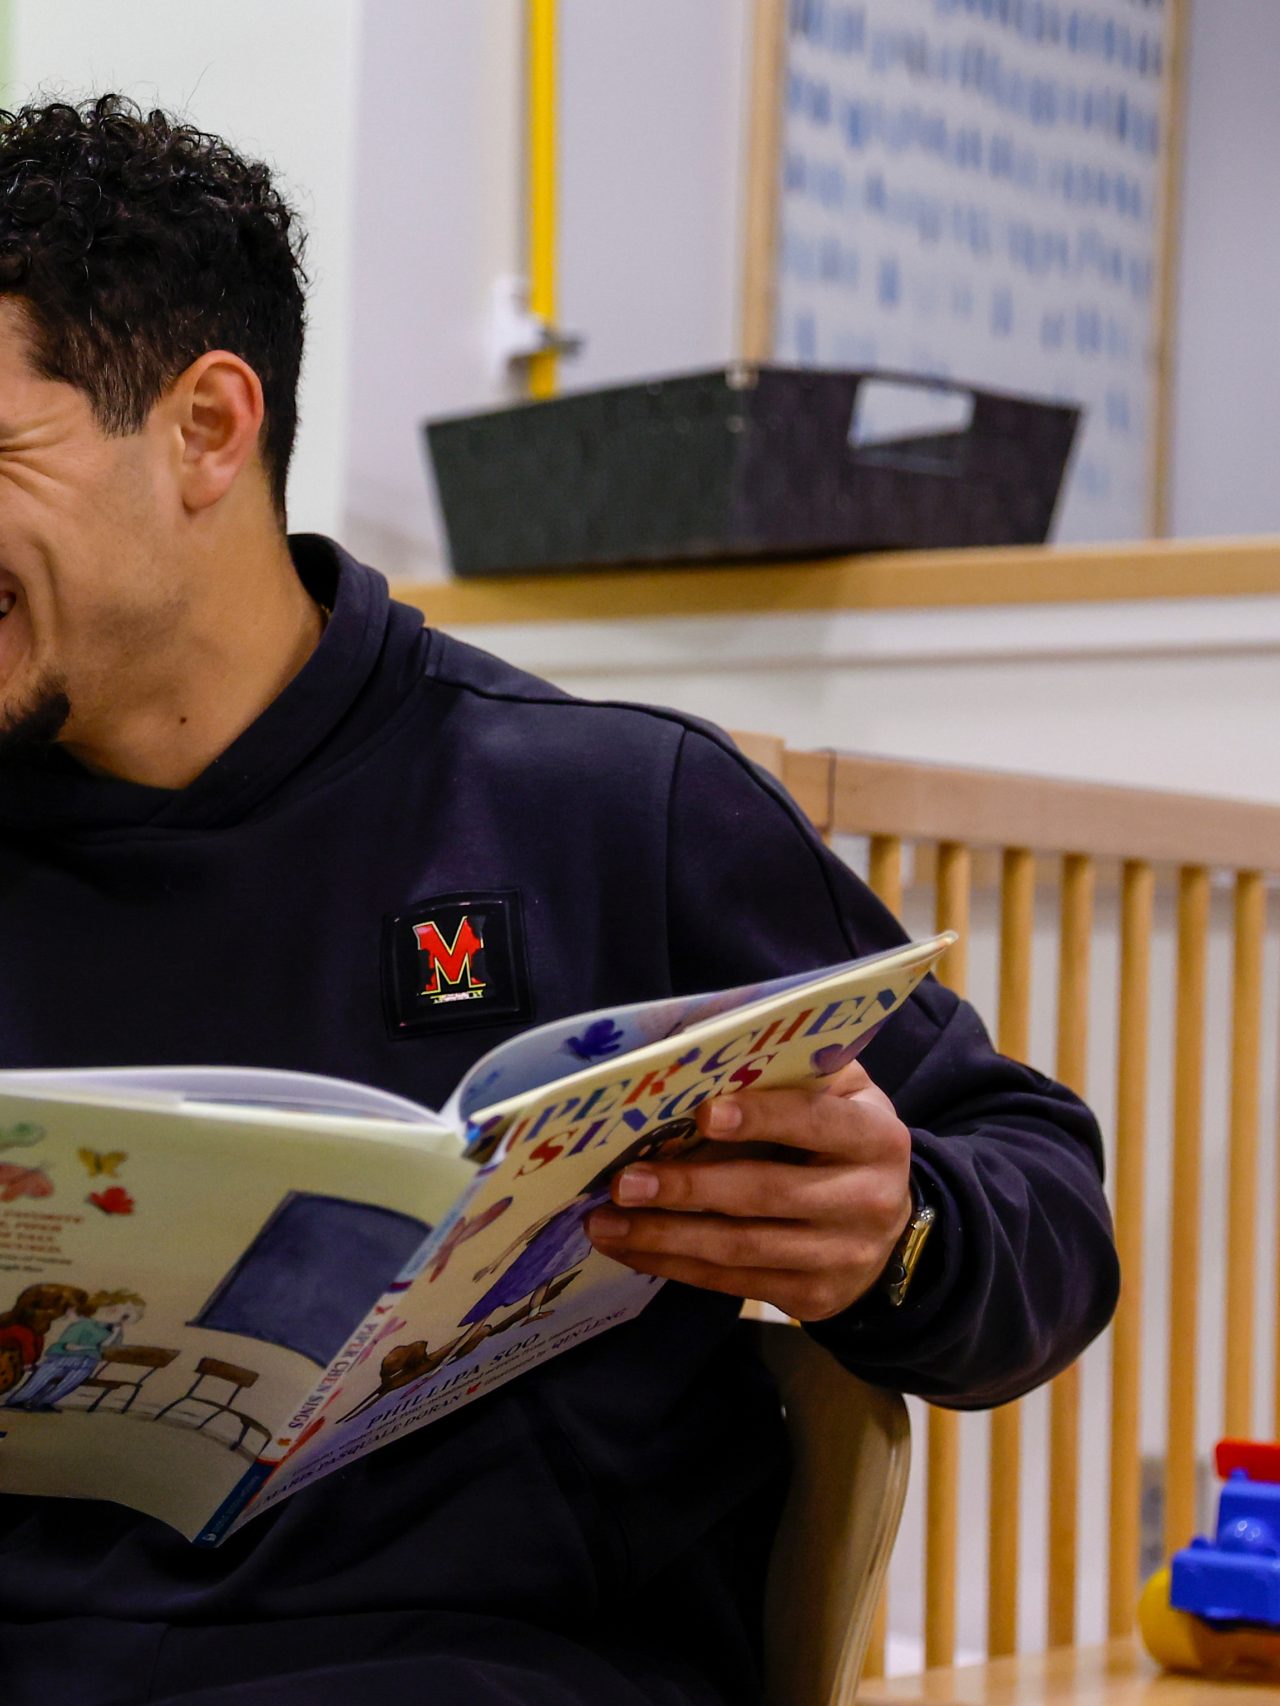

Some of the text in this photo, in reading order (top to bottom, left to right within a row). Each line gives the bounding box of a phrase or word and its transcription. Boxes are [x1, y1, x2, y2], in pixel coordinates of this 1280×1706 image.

[412, 916, 486, 995] M
[513, 1051, 779, 1180] SINGS
[316, 1361, 351, 1393] CHEN
[366, 1363, 481, 1429] PHILLIPA
[490, 1332, 541, 1367] SOO
[288, 1394, 324, 1429] SINGS
[405, 1393, 463, 1428] DORAN
